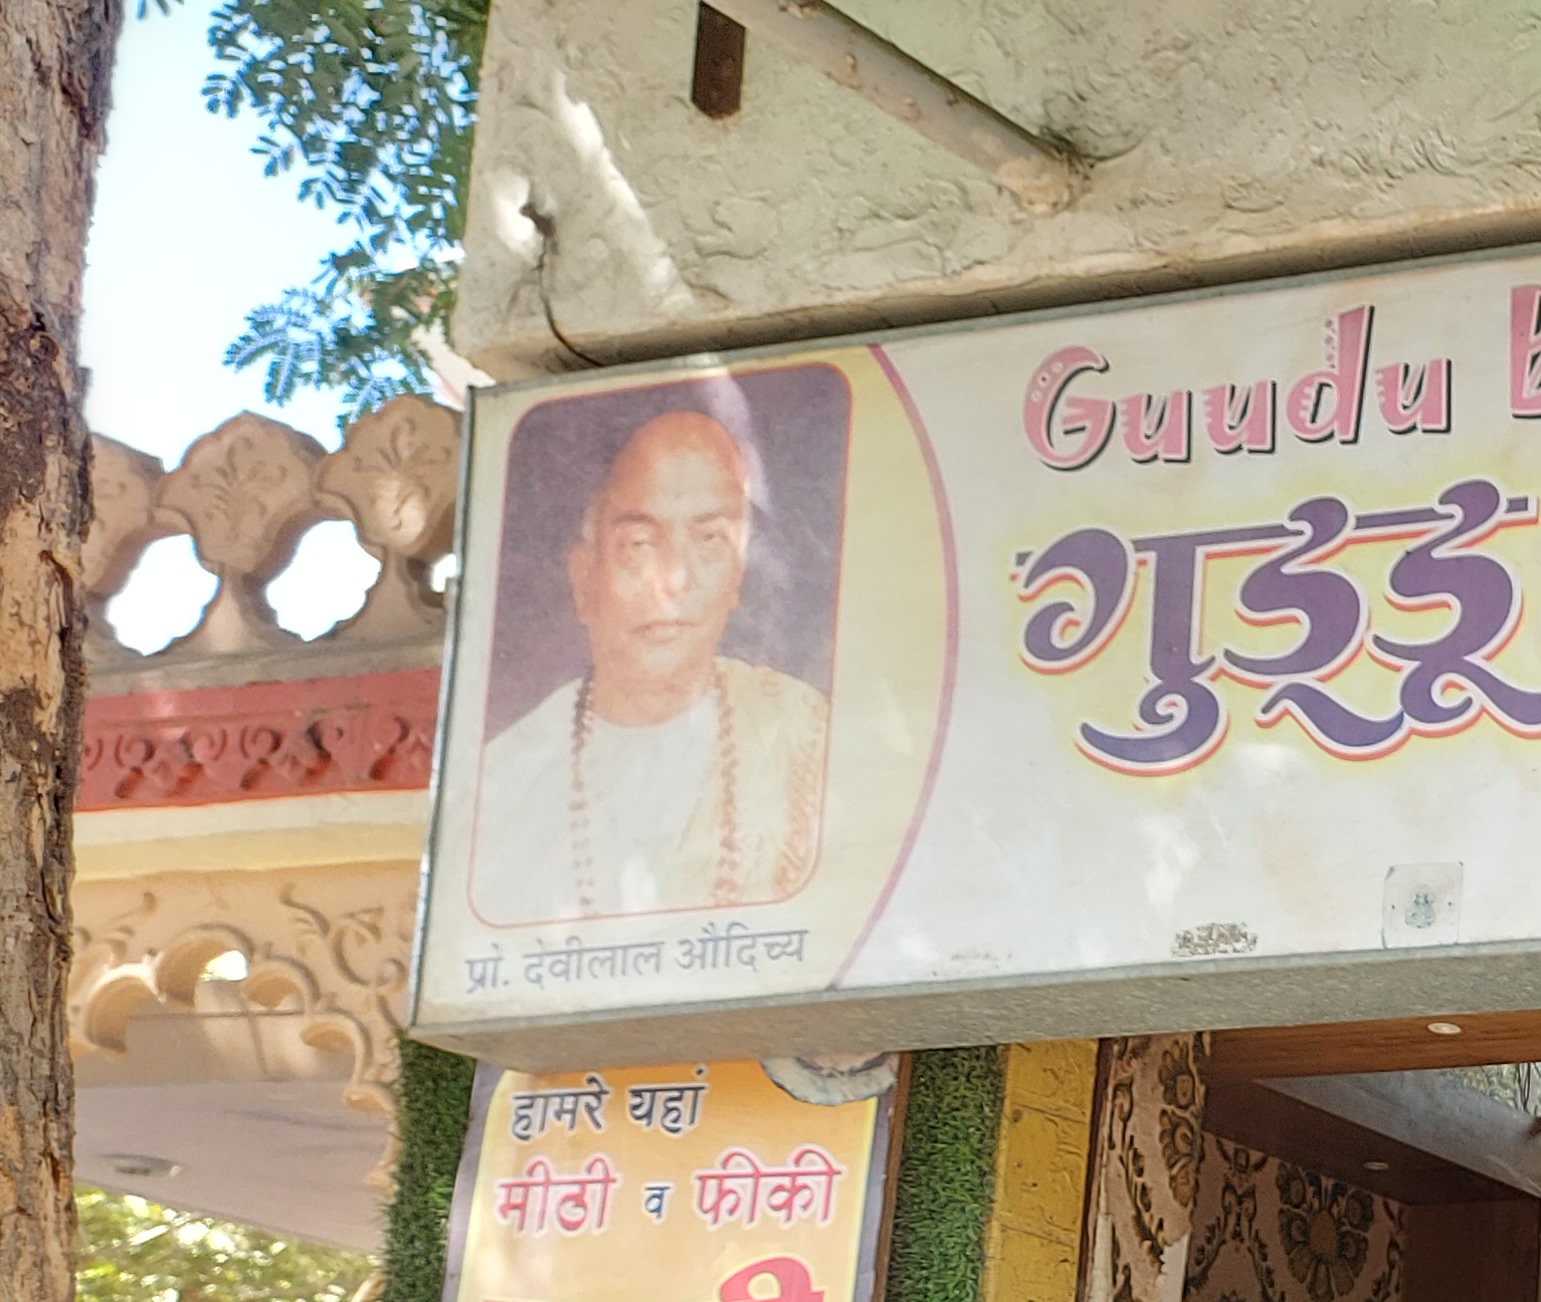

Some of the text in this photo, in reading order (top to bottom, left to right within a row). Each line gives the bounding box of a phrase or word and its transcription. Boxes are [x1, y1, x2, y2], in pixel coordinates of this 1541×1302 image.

[1021, 304, 1451, 473] Guudu
[523, 936, 665, 985] देवीलाल
[675, 922, 810, 972] औदिच्य
[511, 1067, 707, 1141] हामरे यहां
[498, 1147, 842, 1232] मीठी व फीकी
